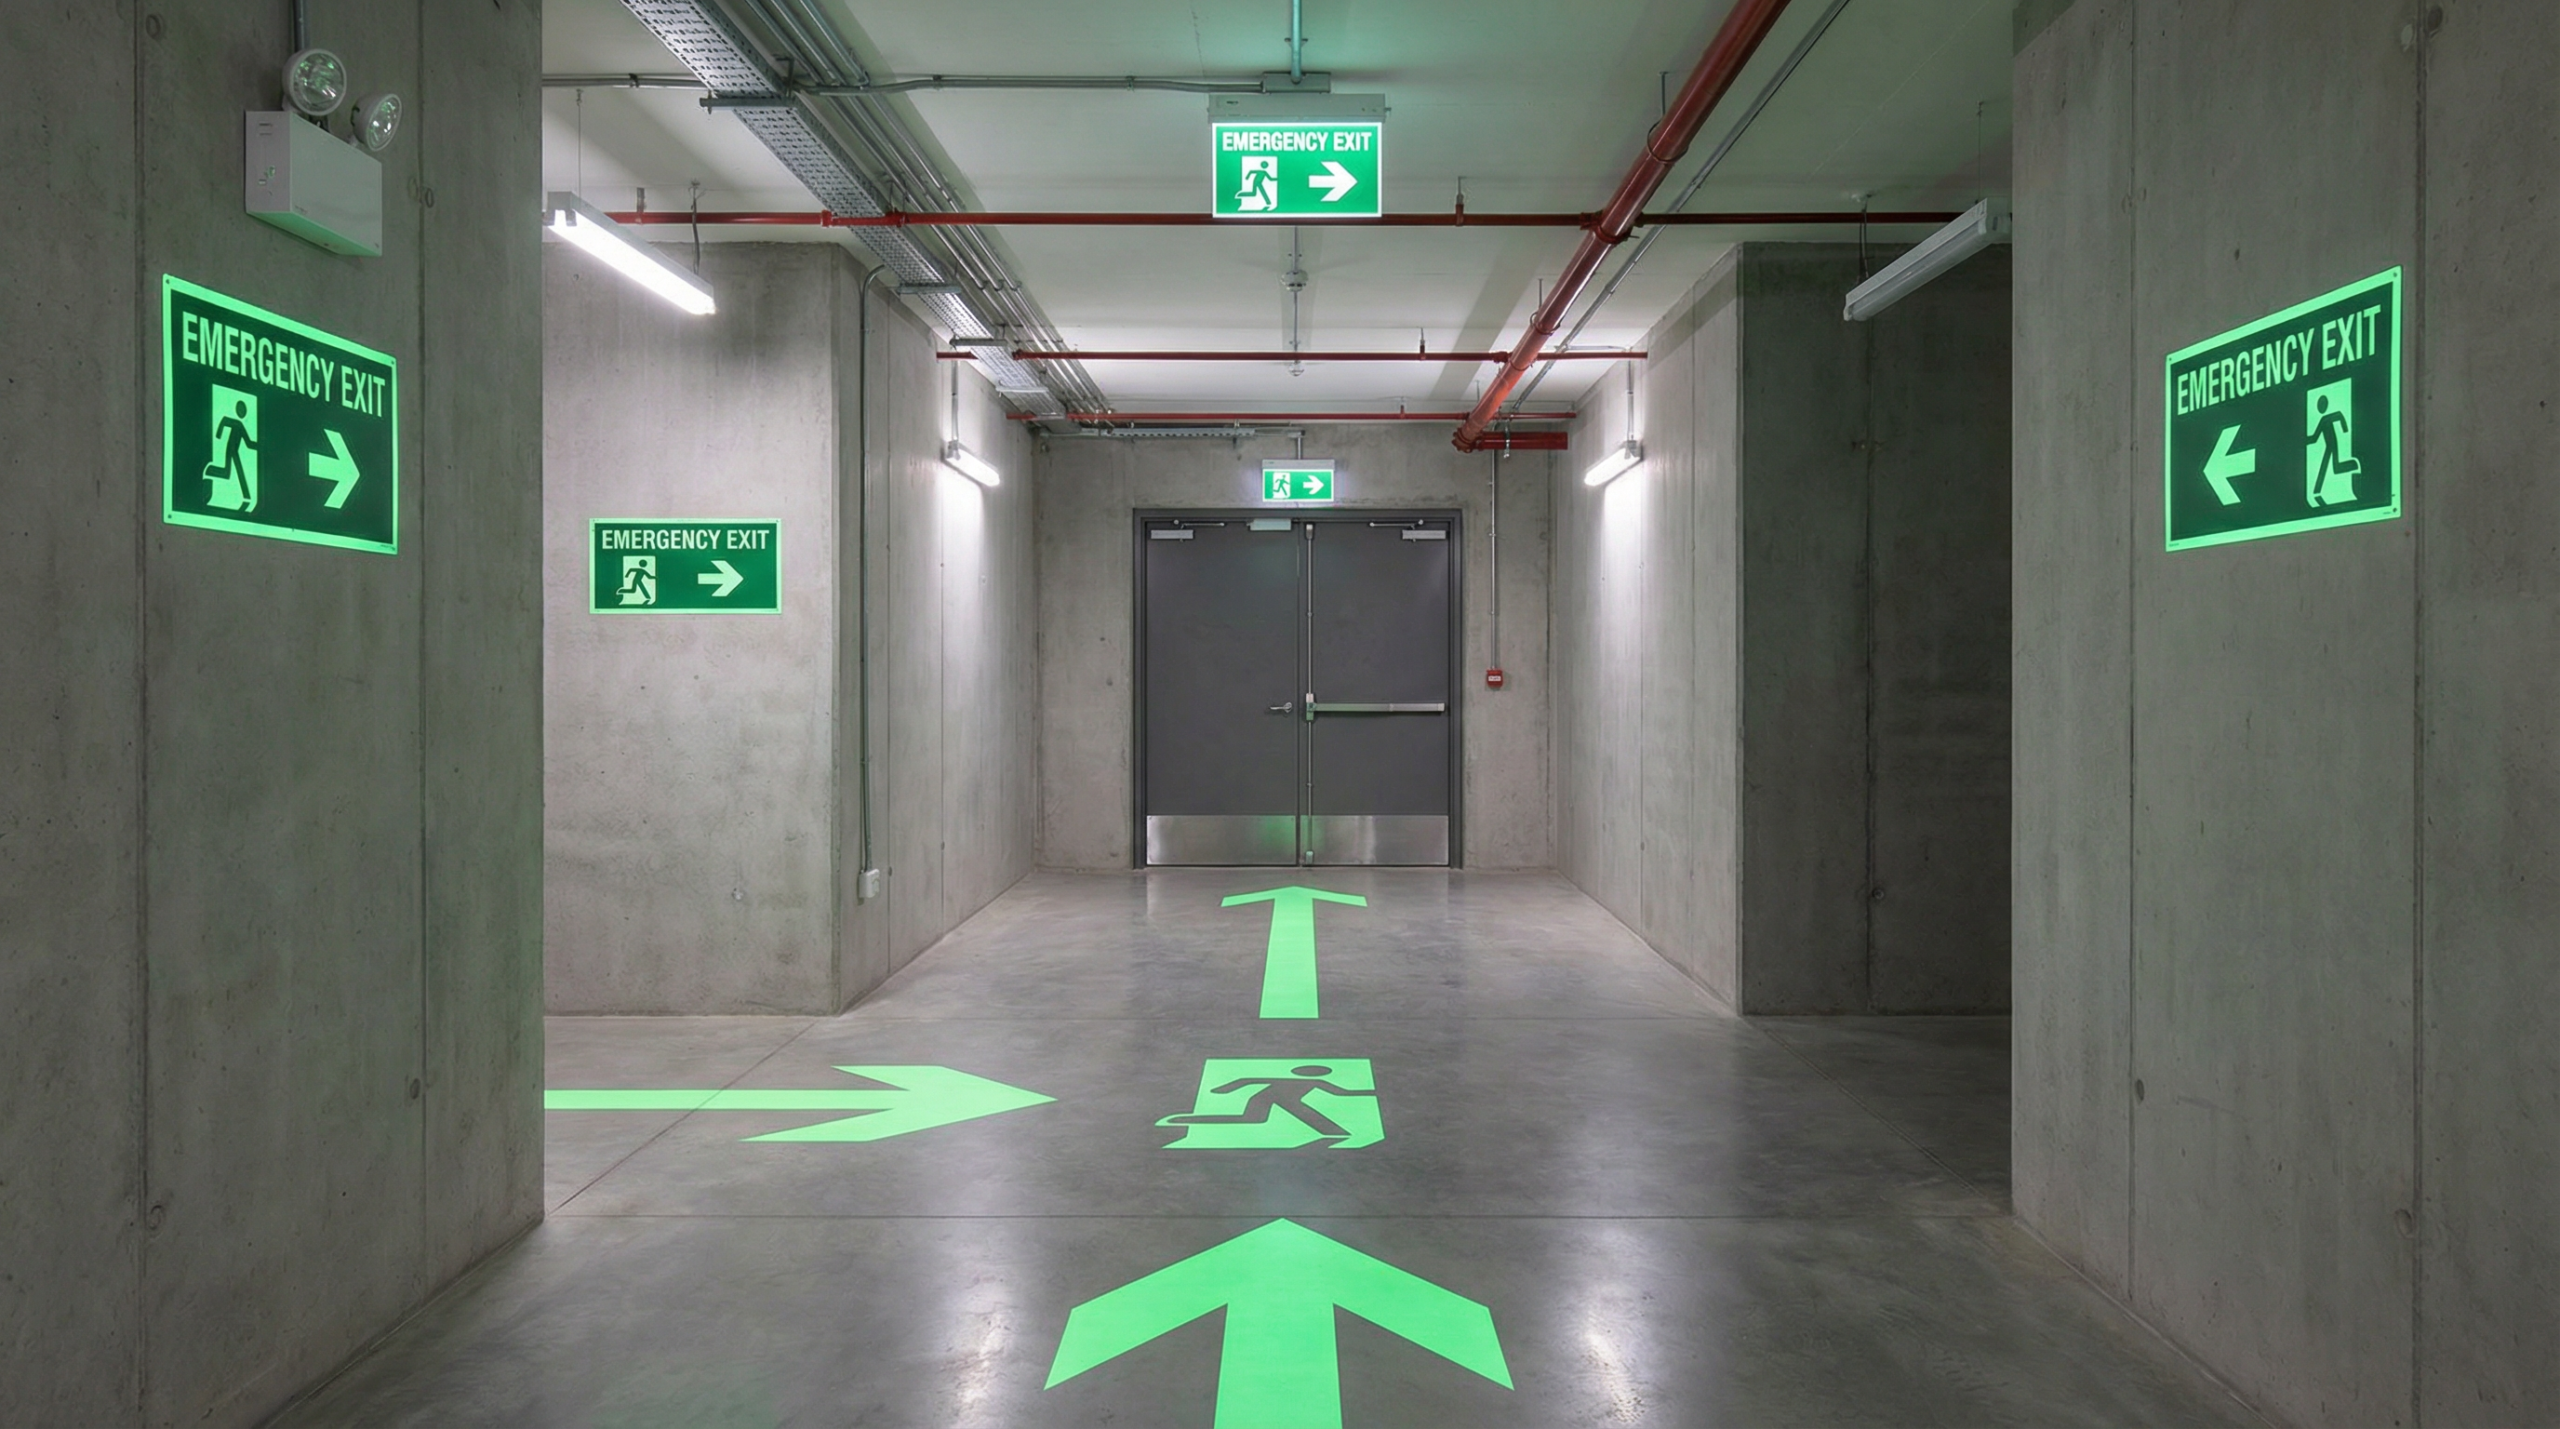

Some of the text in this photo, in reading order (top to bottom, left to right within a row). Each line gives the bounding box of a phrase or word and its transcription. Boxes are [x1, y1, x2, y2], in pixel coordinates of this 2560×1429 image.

[1222, 131, 1372, 151] EMERGENCY EXIT
[182, 310, 386, 418] EMERGENCY EXIT
[2177, 304, 2381, 416] EMERGENCY EXIT
[602, 529, 770, 550] EMERGENCY EXIT
